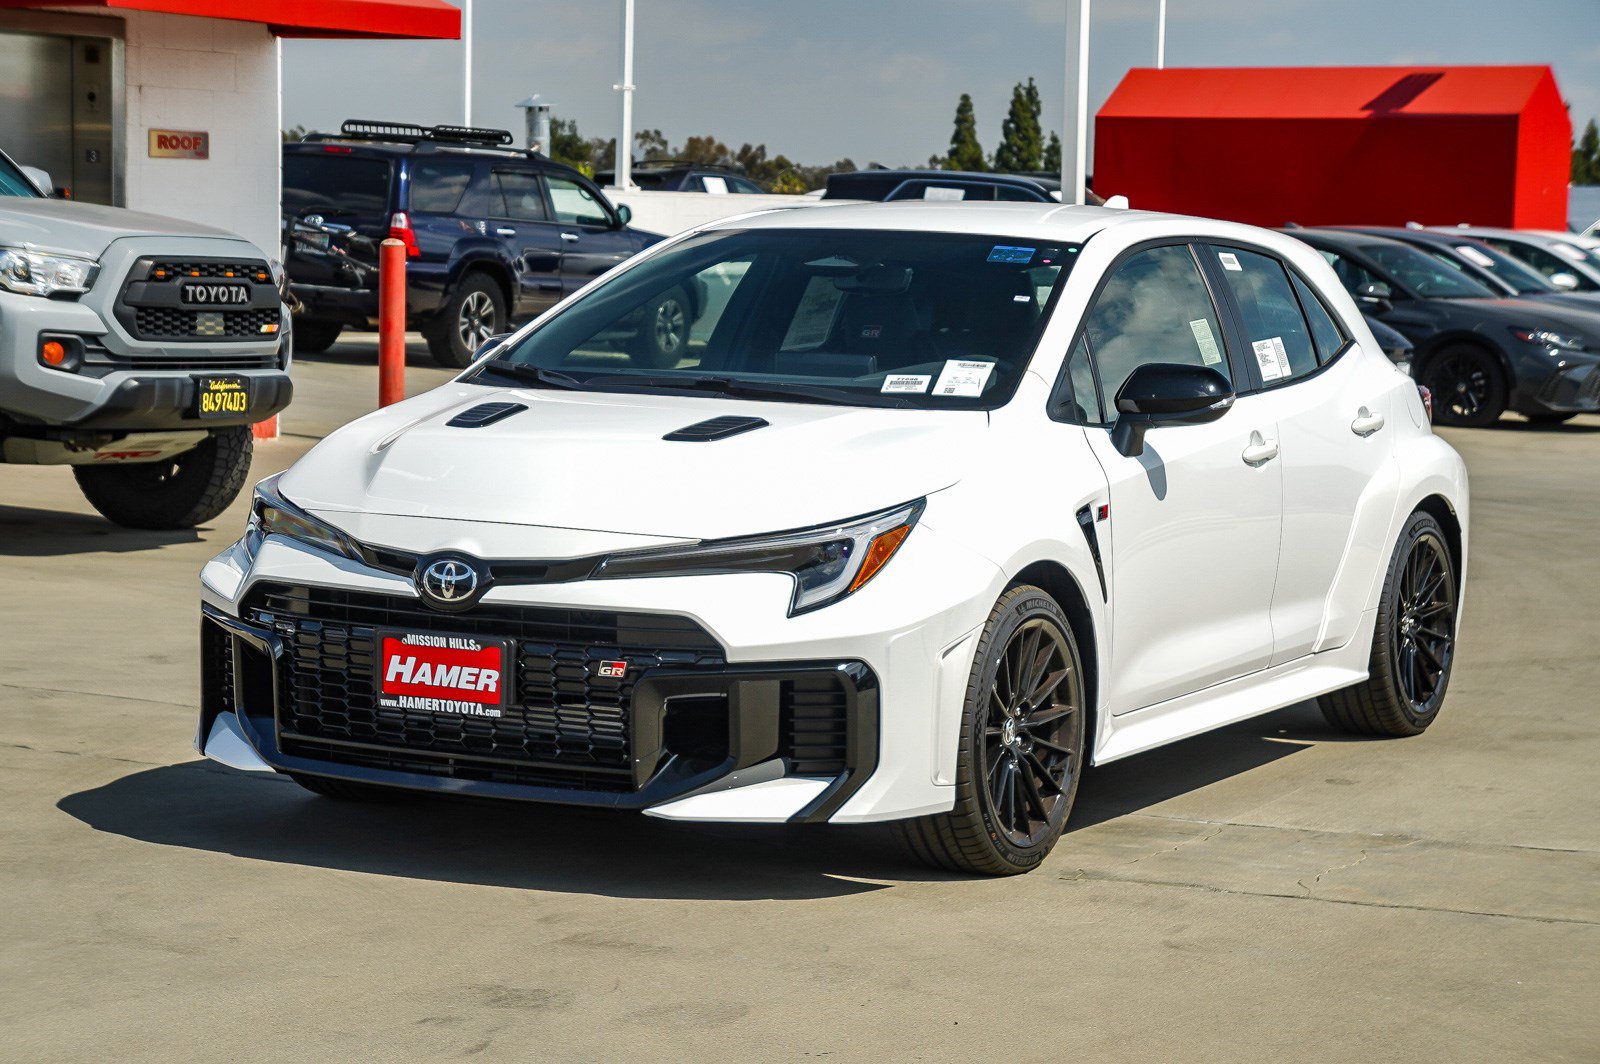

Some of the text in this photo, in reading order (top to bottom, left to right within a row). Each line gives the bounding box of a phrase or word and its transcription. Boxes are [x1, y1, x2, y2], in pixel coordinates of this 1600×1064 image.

[157, 134, 202, 150] ROOF
[185, 285, 248, 303] TOYOTA
[210, 381, 241, 392] California
[202, 392, 247, 412] 84974D3
[1026, 598, 1057, 613] MICHELIN
[406, 634, 476, 651] MISSION HILLS
[385, 654, 500, 693] HAMER
[600, 666, 624, 676] GR
[380, 695, 501, 717] www.HAMERTOYOTA.com
